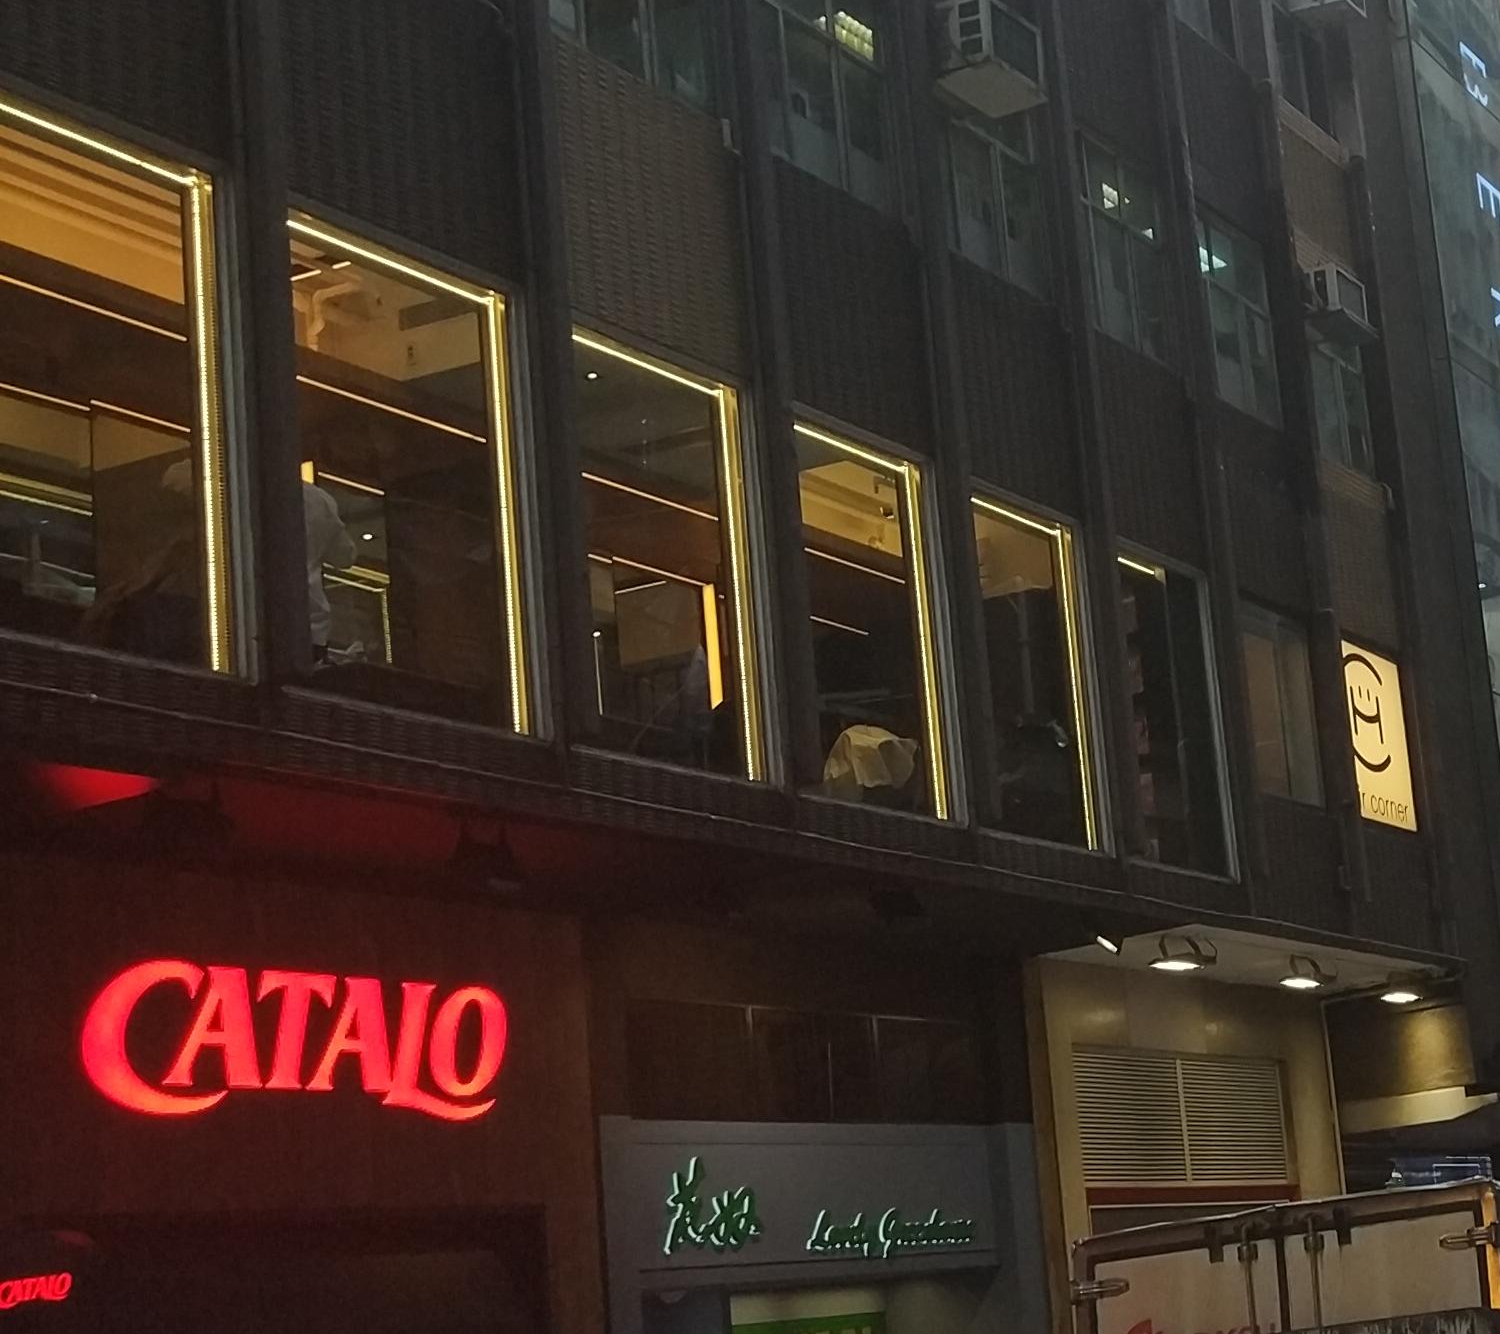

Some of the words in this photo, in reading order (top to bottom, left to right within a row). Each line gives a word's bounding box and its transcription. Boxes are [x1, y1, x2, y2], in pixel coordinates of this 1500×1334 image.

[1369, 794, 1409, 824] corner
[80, 958, 508, 1121] CATALO
[0, 1272, 73, 1309] CATALO
